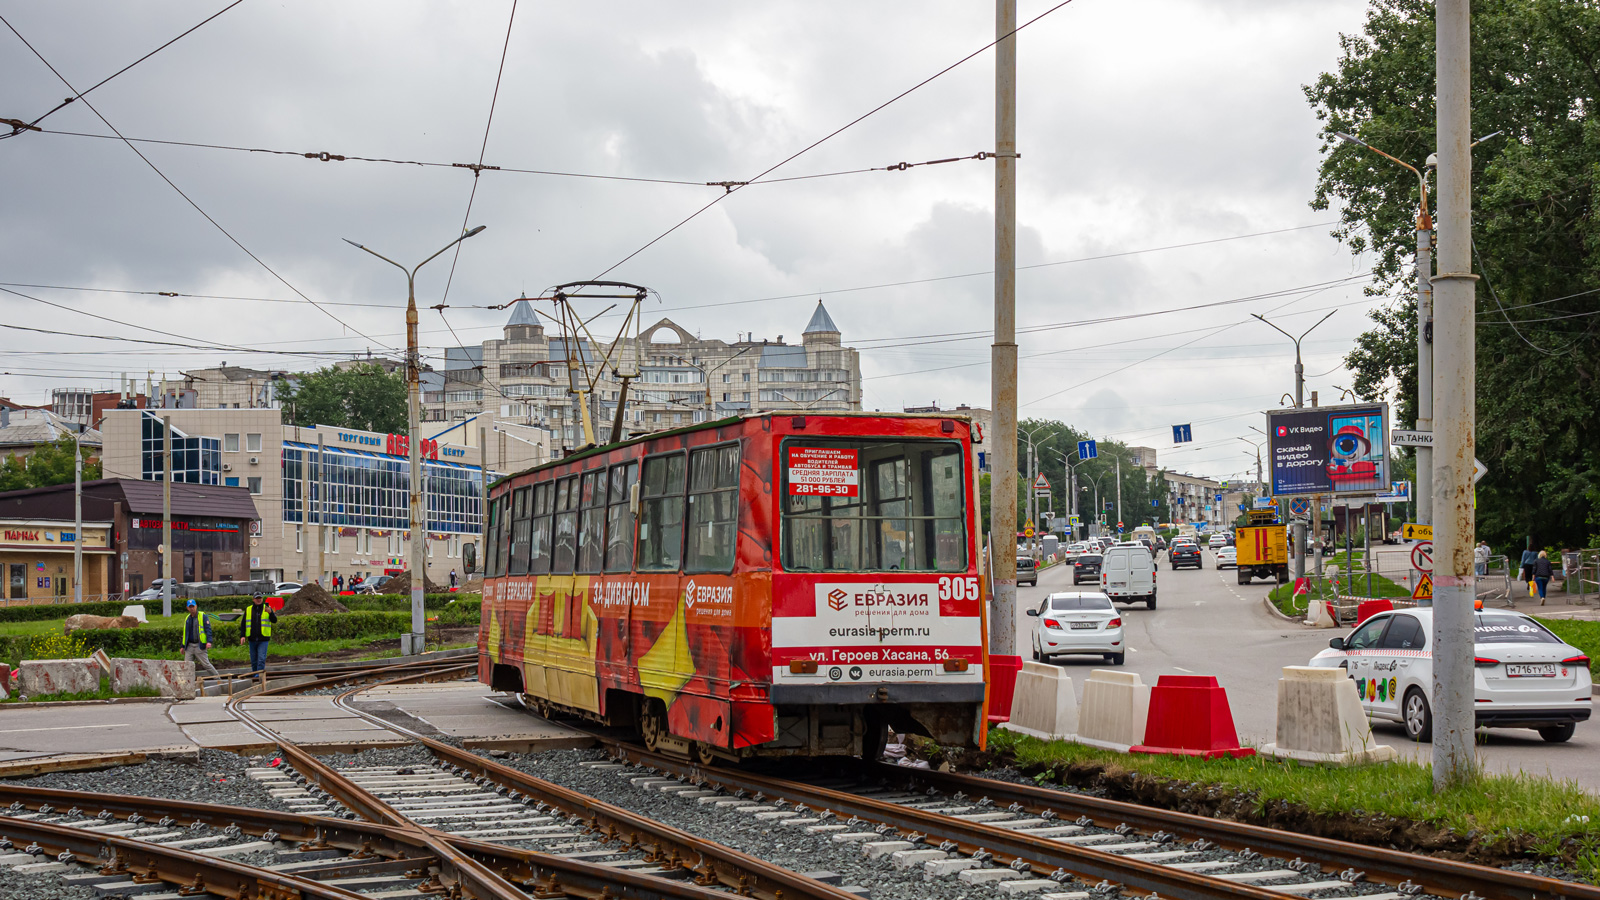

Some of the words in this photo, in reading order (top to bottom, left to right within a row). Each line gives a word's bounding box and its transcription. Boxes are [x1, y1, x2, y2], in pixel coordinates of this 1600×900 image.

[1393, 434, 1405, 443] ул.
[1406, 434, 1433, 442] ТАНКИ
[338, 432, 381, 446] ТОРГОВЫЙ
[386, 432, 438, 460] АВРРА
[442, 447, 465, 457] ЦЕНТР
[1276, 444, 1312, 454] скачай
[1286, 459, 1324, 468] дорогу
[796, 484, 848, 494] 281-96-30
[4, 530, 39, 541] ПАРНАС
[697, 586, 732, 603] ЕВРАЗИЯ
[939, 577, 979, 600] 305
[593, 582, 603, 604] ЗА
[604, 582, 650, 608] ДИВАНОМ
[854, 594, 928, 606] ЕВРАЗИЯ
[829, 626, 930, 639] eurasia-perm.ru
[809, 652, 828, 662] ул.
[832, 649, 879, 663] Героев
[882, 650, 931, 662] Хасана,
[934, 649, 949, 660] 56
[869, 667, 933, 678] eurasia.perm
